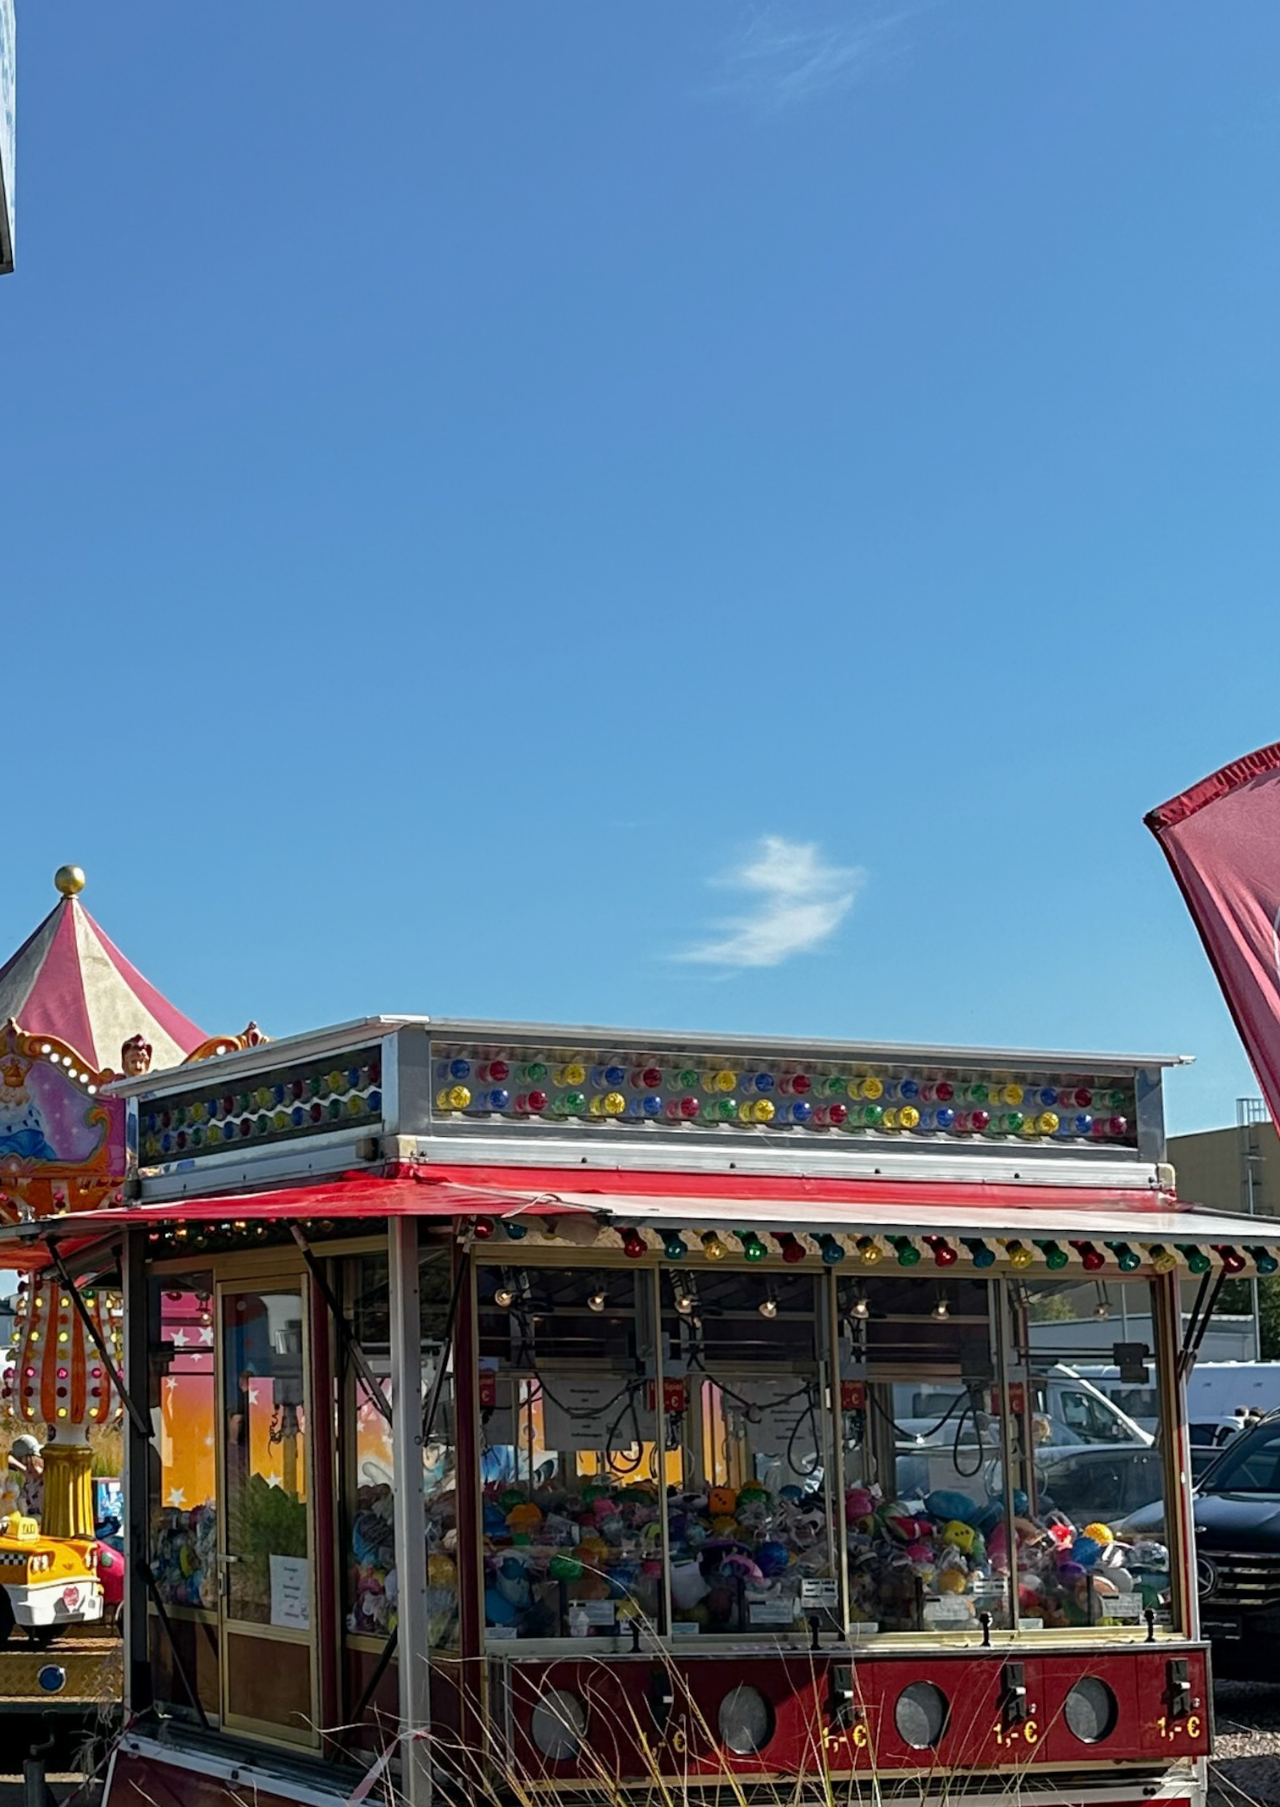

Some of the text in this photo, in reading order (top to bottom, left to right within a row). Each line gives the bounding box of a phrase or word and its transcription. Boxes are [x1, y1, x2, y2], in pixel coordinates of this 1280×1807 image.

[852, 1725, 866, 1747] €
[1023, 1721, 1037, 1743] €
[1187, 1716, 1200, 1738] €
